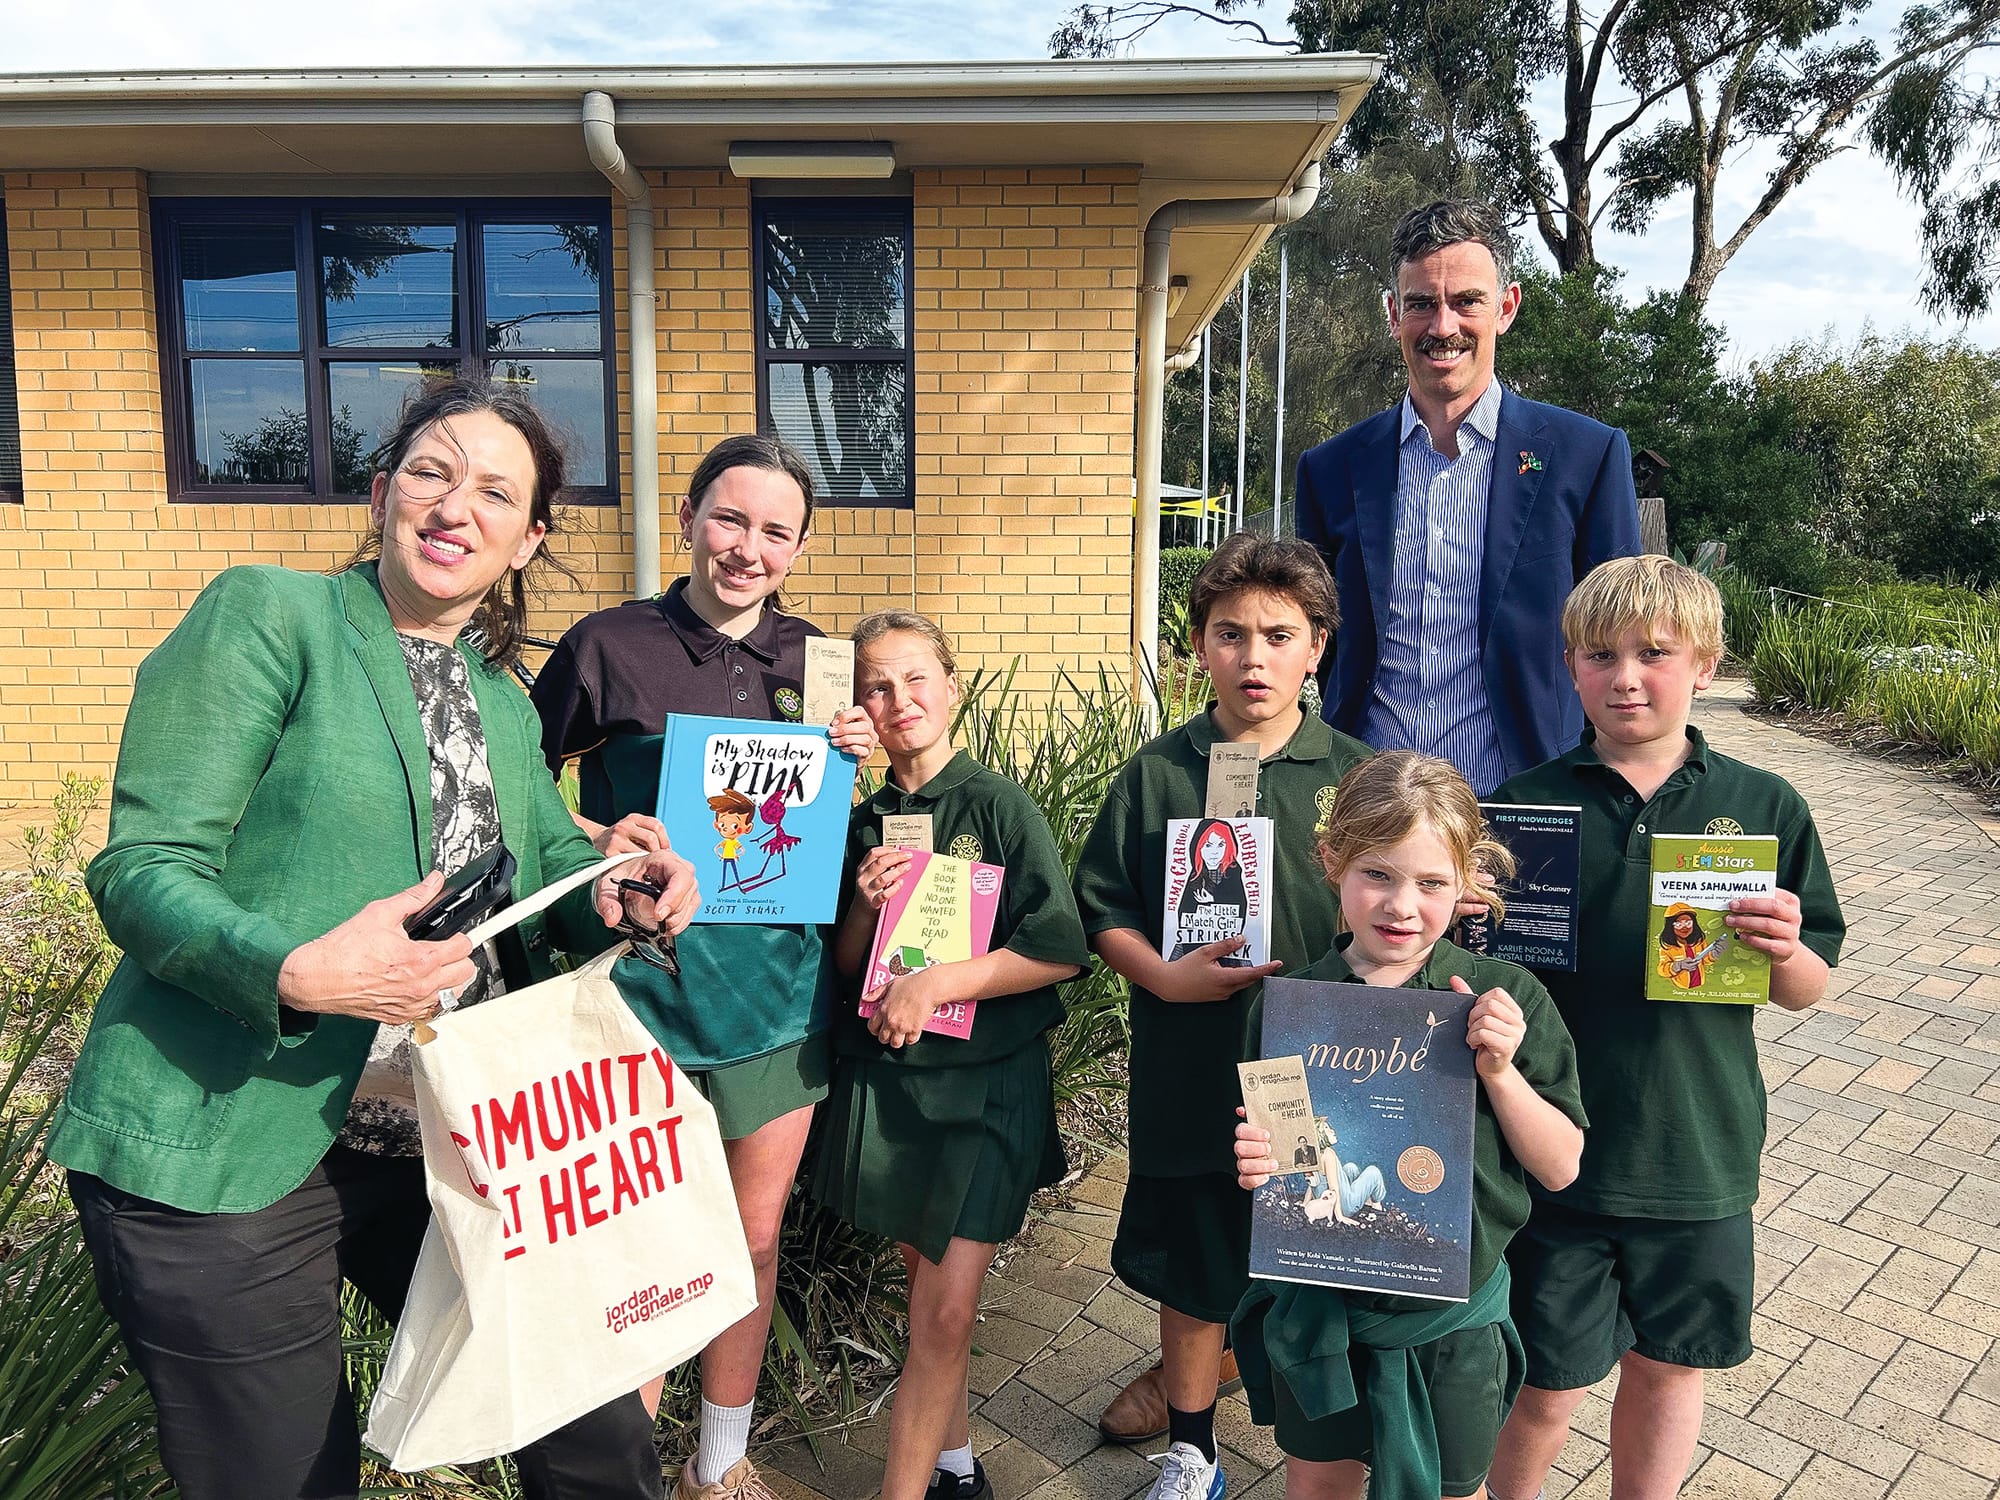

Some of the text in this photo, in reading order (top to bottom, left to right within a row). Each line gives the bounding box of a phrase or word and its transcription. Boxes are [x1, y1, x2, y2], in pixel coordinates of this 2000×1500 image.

[714, 739, 814, 761] My Shadow
[712, 759, 810, 802] is PINK
[1518, 816, 1574, 825] KNOWLEDGES
[1698, 842, 1734, 854] Aussie
[1676, 853, 1754, 868] STEM Stars
[943, 864, 957, 872] THE
[1168, 824, 1190, 912] EMMA CARROLL
[1235, 823, 1260, 917] LAUREN CHILD
[934, 873, 957, 884] BOOK
[934, 884, 955, 893] THAT
[1528, 883, 1572, 894] Sky Country
[1662, 881, 1767, 892] VEENA SAHAJWALLA
[925, 892, 957, 904] NO ONE
[704, 905, 737, 915] SCOTT
[920, 905, 956, 916] WANTED
[1214, 905, 1237, 916] Little
[926, 917, 940, 926] TO
[1185, 914, 1236, 930] Match Girl
[921, 928, 949, 938] READ
[1524, 946, 1555, 955] NOON
[1525, 954, 1536, 962] DE
[1537, 955, 1568, 965] NAPOLI
[1307, 1037, 1428, 1084] maybe
[1260, 1072, 1280, 1081] jordan
[1268, 1098, 1305, 1112] COMMUNITY
[1287, 1108, 1307, 1119] HEART
[540, 1115, 683, 1244] HEART
[1276, 1247, 1298, 1256] Written
[1299, 1250, 1306, 1259] by
[1322, 1253, 1344, 1262] Yamada
[1391, 1262, 1417, 1271] Gabriella
[606, 1285, 659, 1328] jordan
[614, 1272, 714, 1333] crugnale mp
